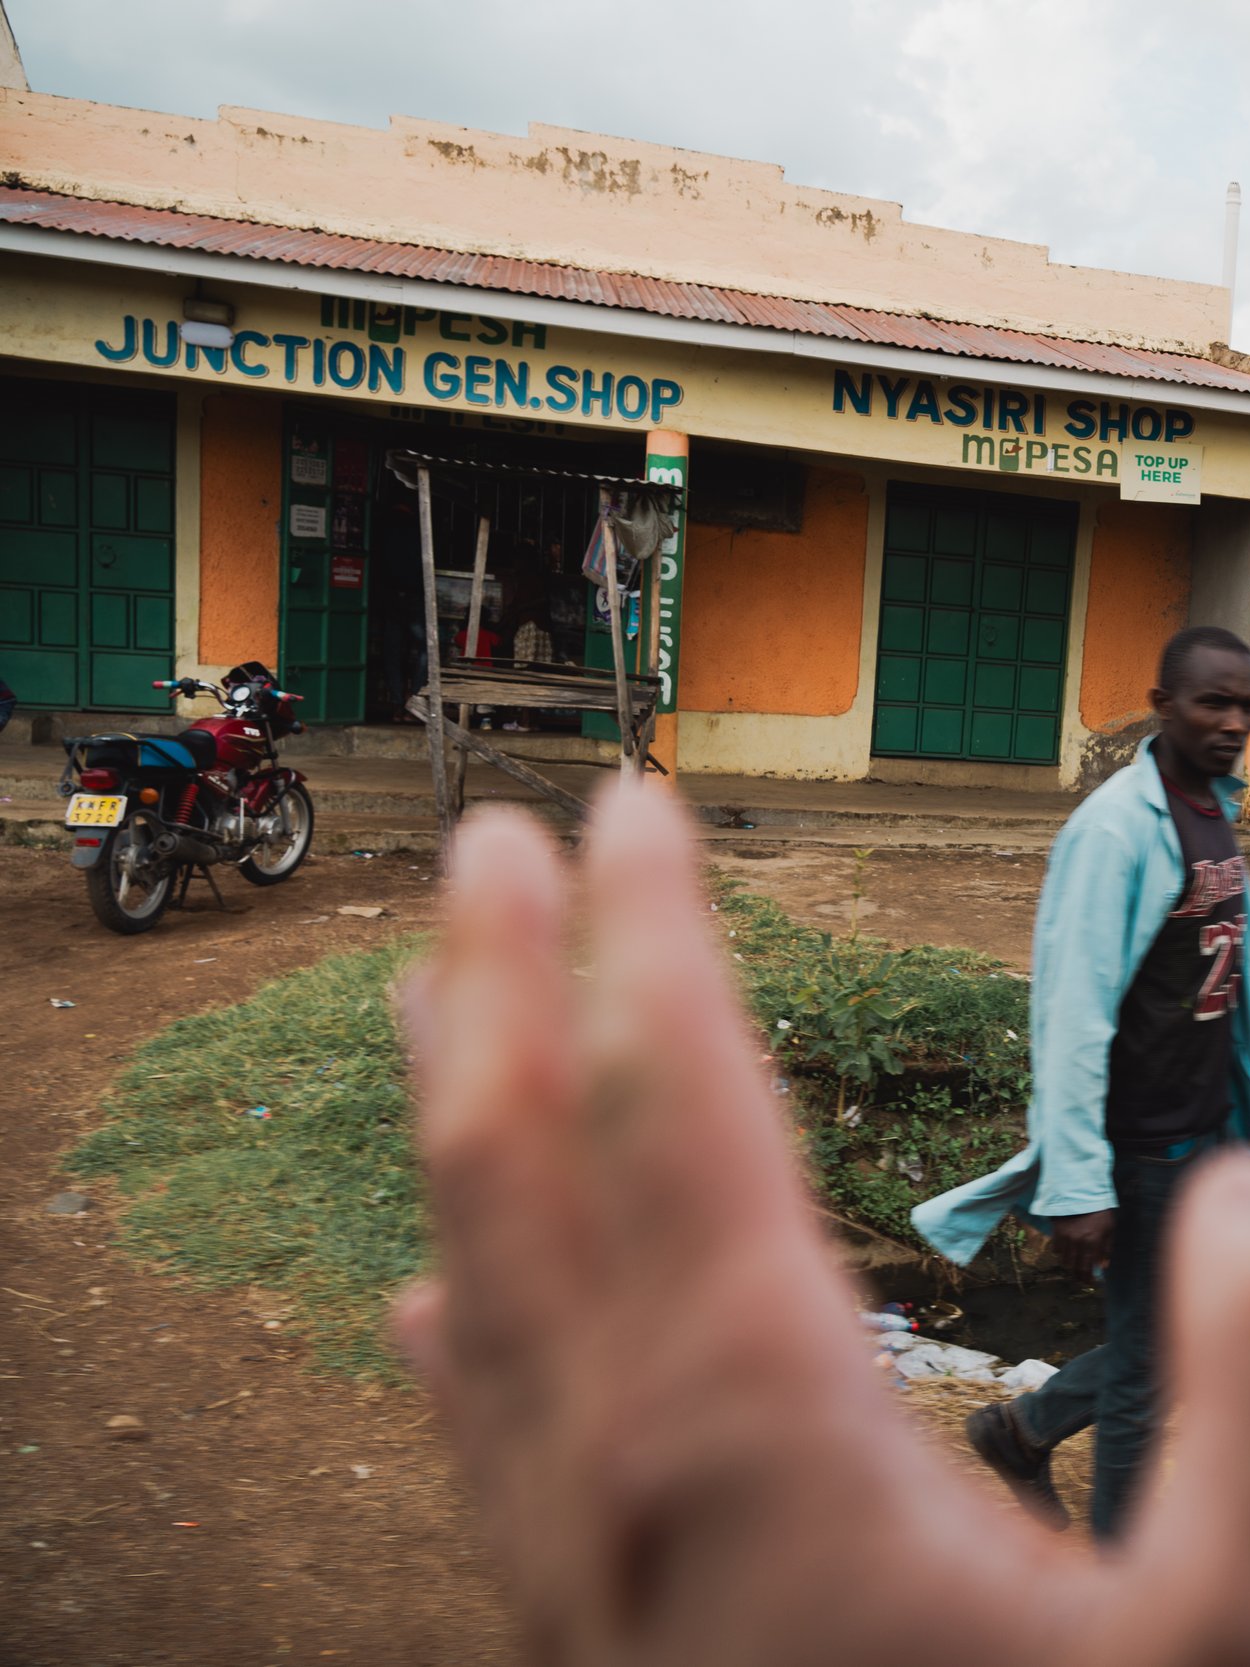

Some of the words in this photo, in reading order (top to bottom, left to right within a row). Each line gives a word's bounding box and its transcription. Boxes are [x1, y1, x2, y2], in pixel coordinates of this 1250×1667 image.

[95, 315, 405, 395] JUNCTION
[832, 368, 1046, 437] NYASIRI
[1063, 400, 1195, 444] SHOP
[1135, 454, 1165, 468] TOP
[1168, 457, 1189, 470] UP
[1141, 470, 1182, 484] HERE
